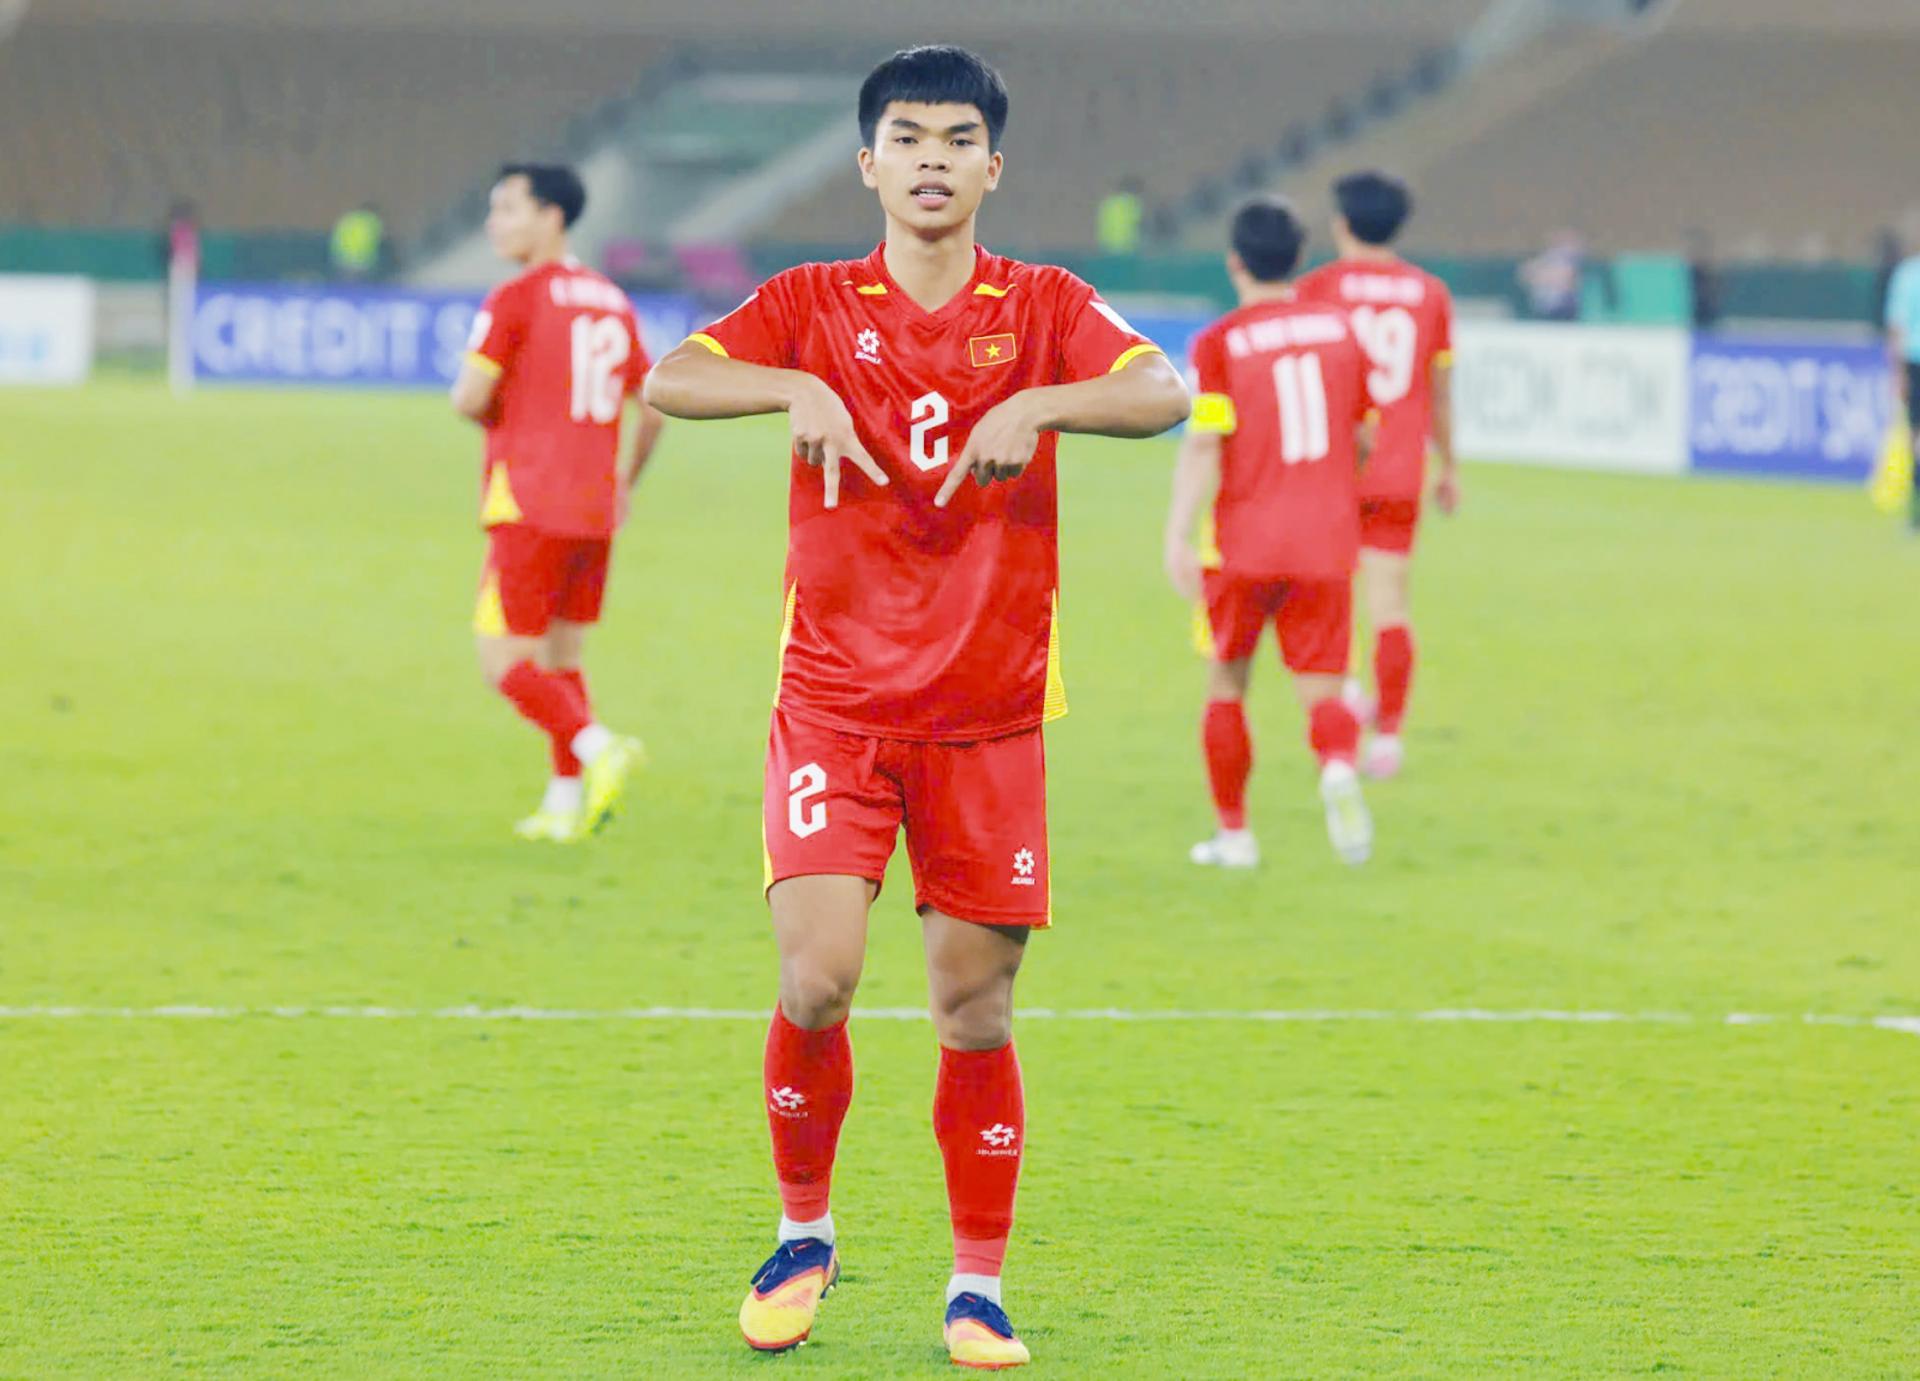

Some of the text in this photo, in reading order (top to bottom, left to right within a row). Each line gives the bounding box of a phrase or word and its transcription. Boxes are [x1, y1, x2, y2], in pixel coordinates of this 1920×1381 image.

[194, 293, 428, 377] CREDIT
[570, 313, 630, 423] 12
[910, 390, 949, 472] 2
[1272, 351, 1329, 464] 11
[788, 761, 827, 839] 2
